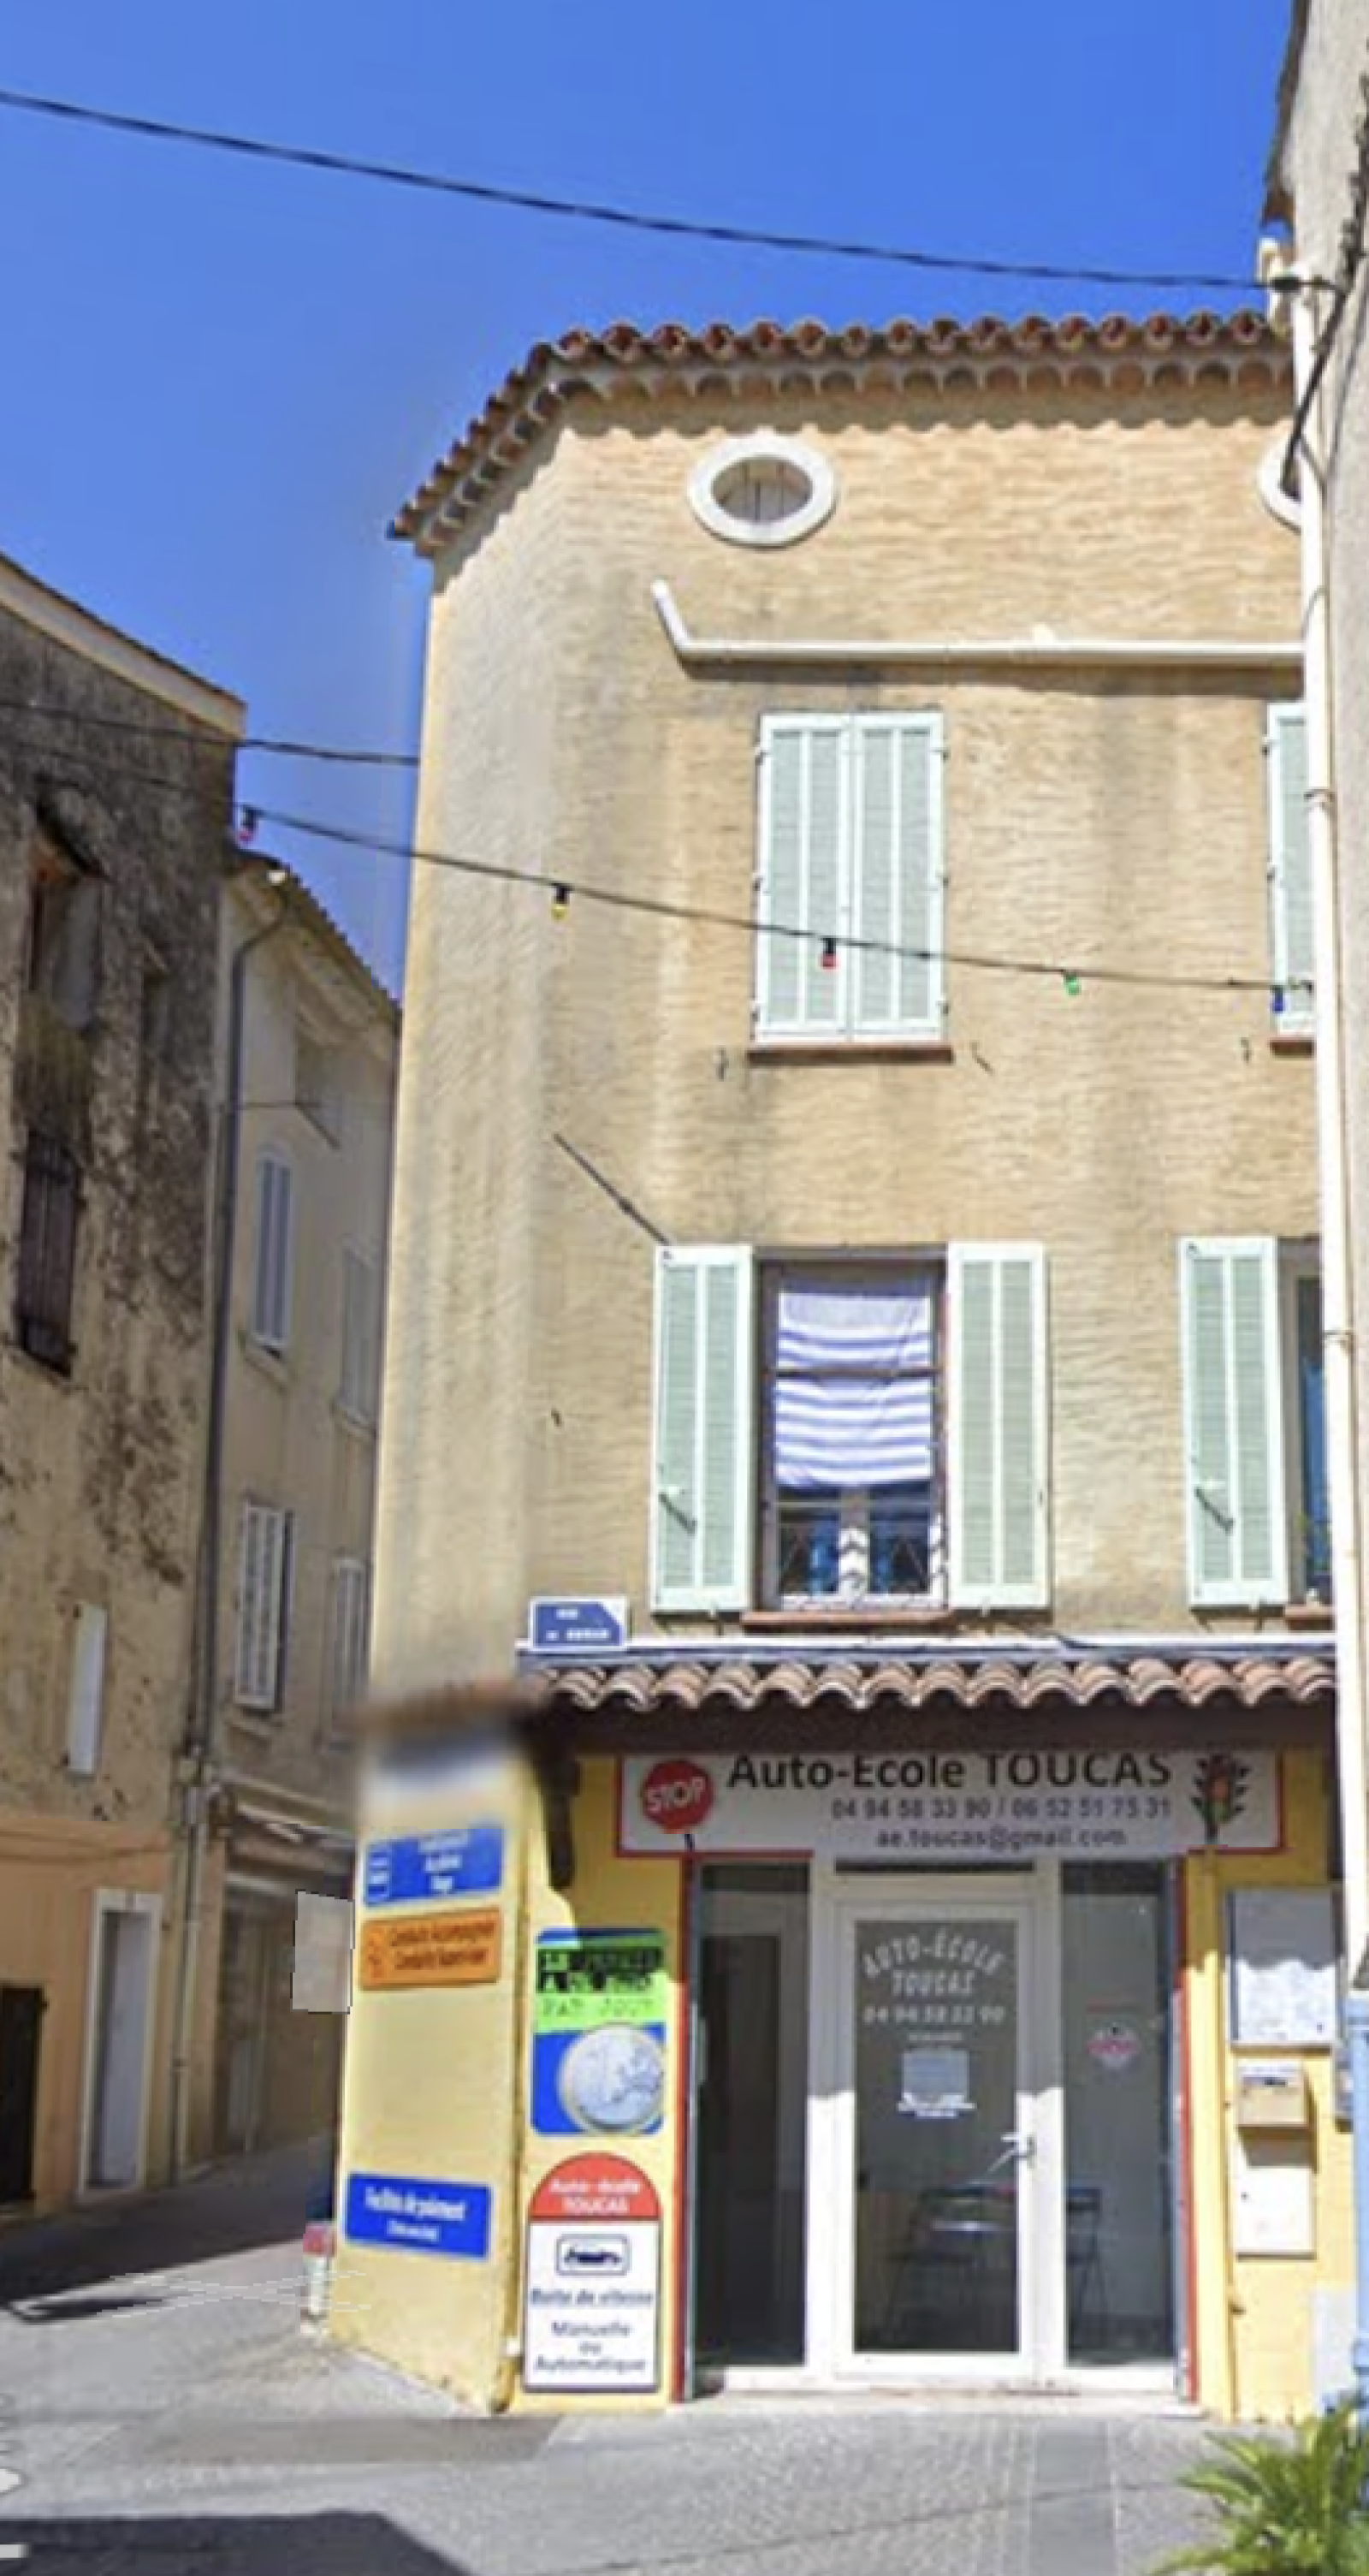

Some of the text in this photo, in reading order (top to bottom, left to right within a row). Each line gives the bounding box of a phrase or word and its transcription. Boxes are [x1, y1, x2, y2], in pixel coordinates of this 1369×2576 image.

[983, 1753, 1171, 1788] TOUCAS
[646, 1775, 707, 1815] STOP
[831, 1799, 856, 1819] 04
[997, 1799, 1005, 1819] /
[877, 1825, 1128, 1851] ae.toucas@gmail.com
[891, 1971, 976, 1997] TOUCAS
[561, 2196, 630, 2216] TOUCAS
[551, 2319, 631, 2338] Manuelle
[578, 2342, 603, 2356] ou
[534, 2354, 647, 2375] Automatique
